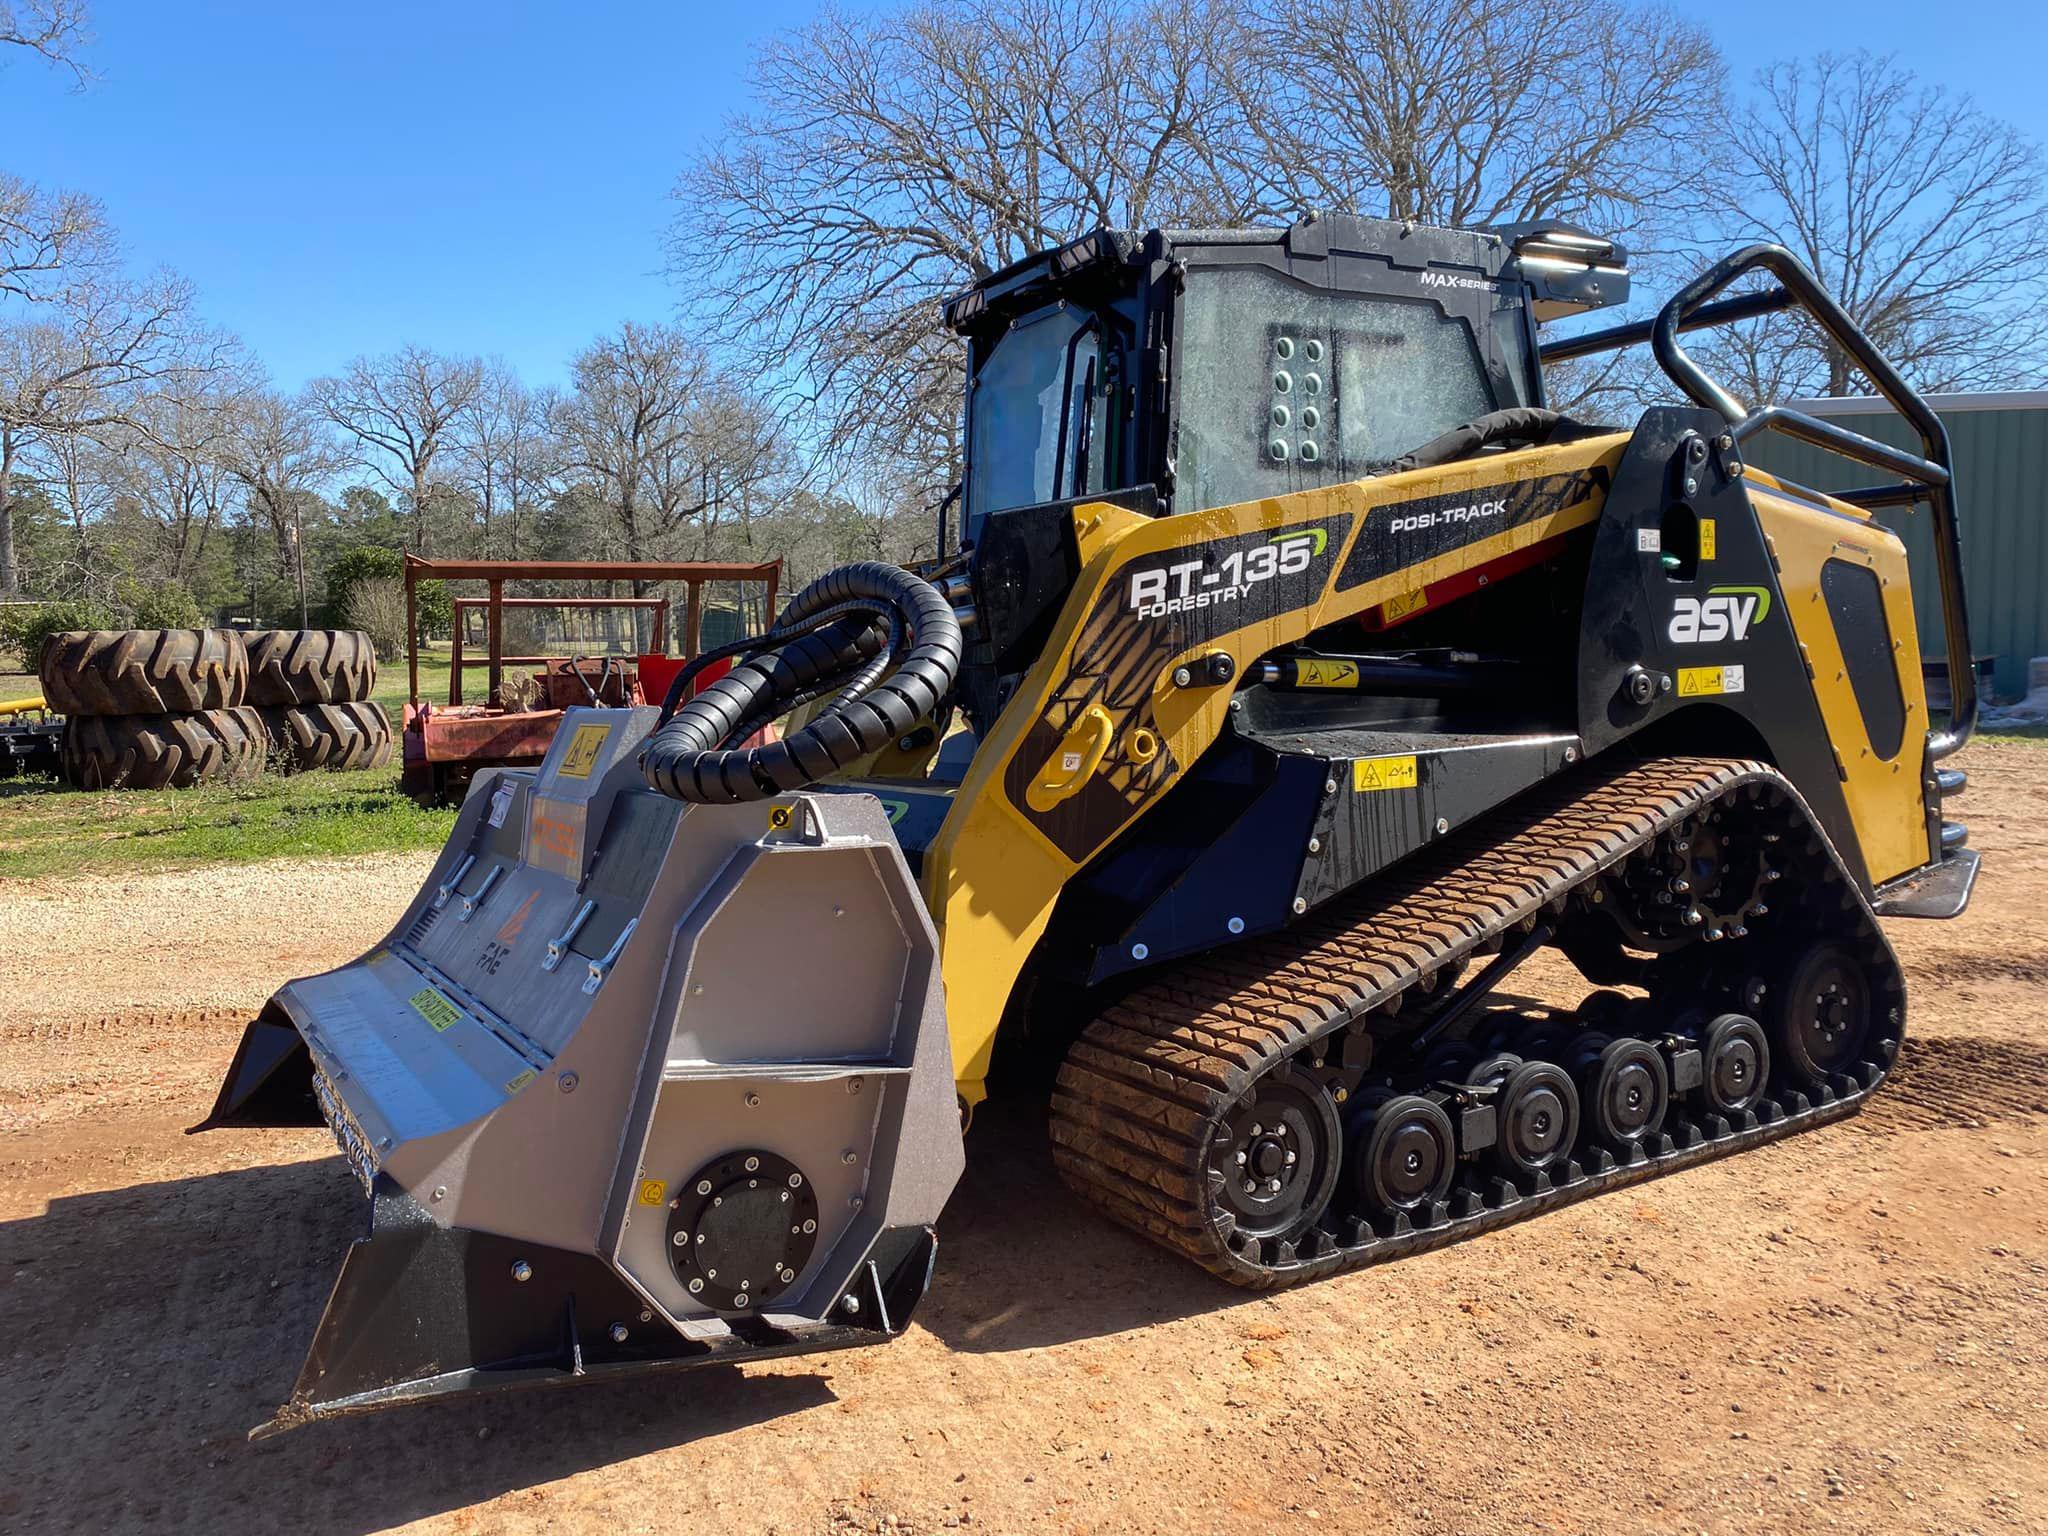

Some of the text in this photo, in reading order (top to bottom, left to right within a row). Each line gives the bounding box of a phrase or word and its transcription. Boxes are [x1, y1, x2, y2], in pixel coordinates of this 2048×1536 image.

[1390, 499, 1506, 534] POSI-TRACK
[1130, 537, 1311, 609] RT-135
[1137, 583, 1254, 621] FORESTRY
